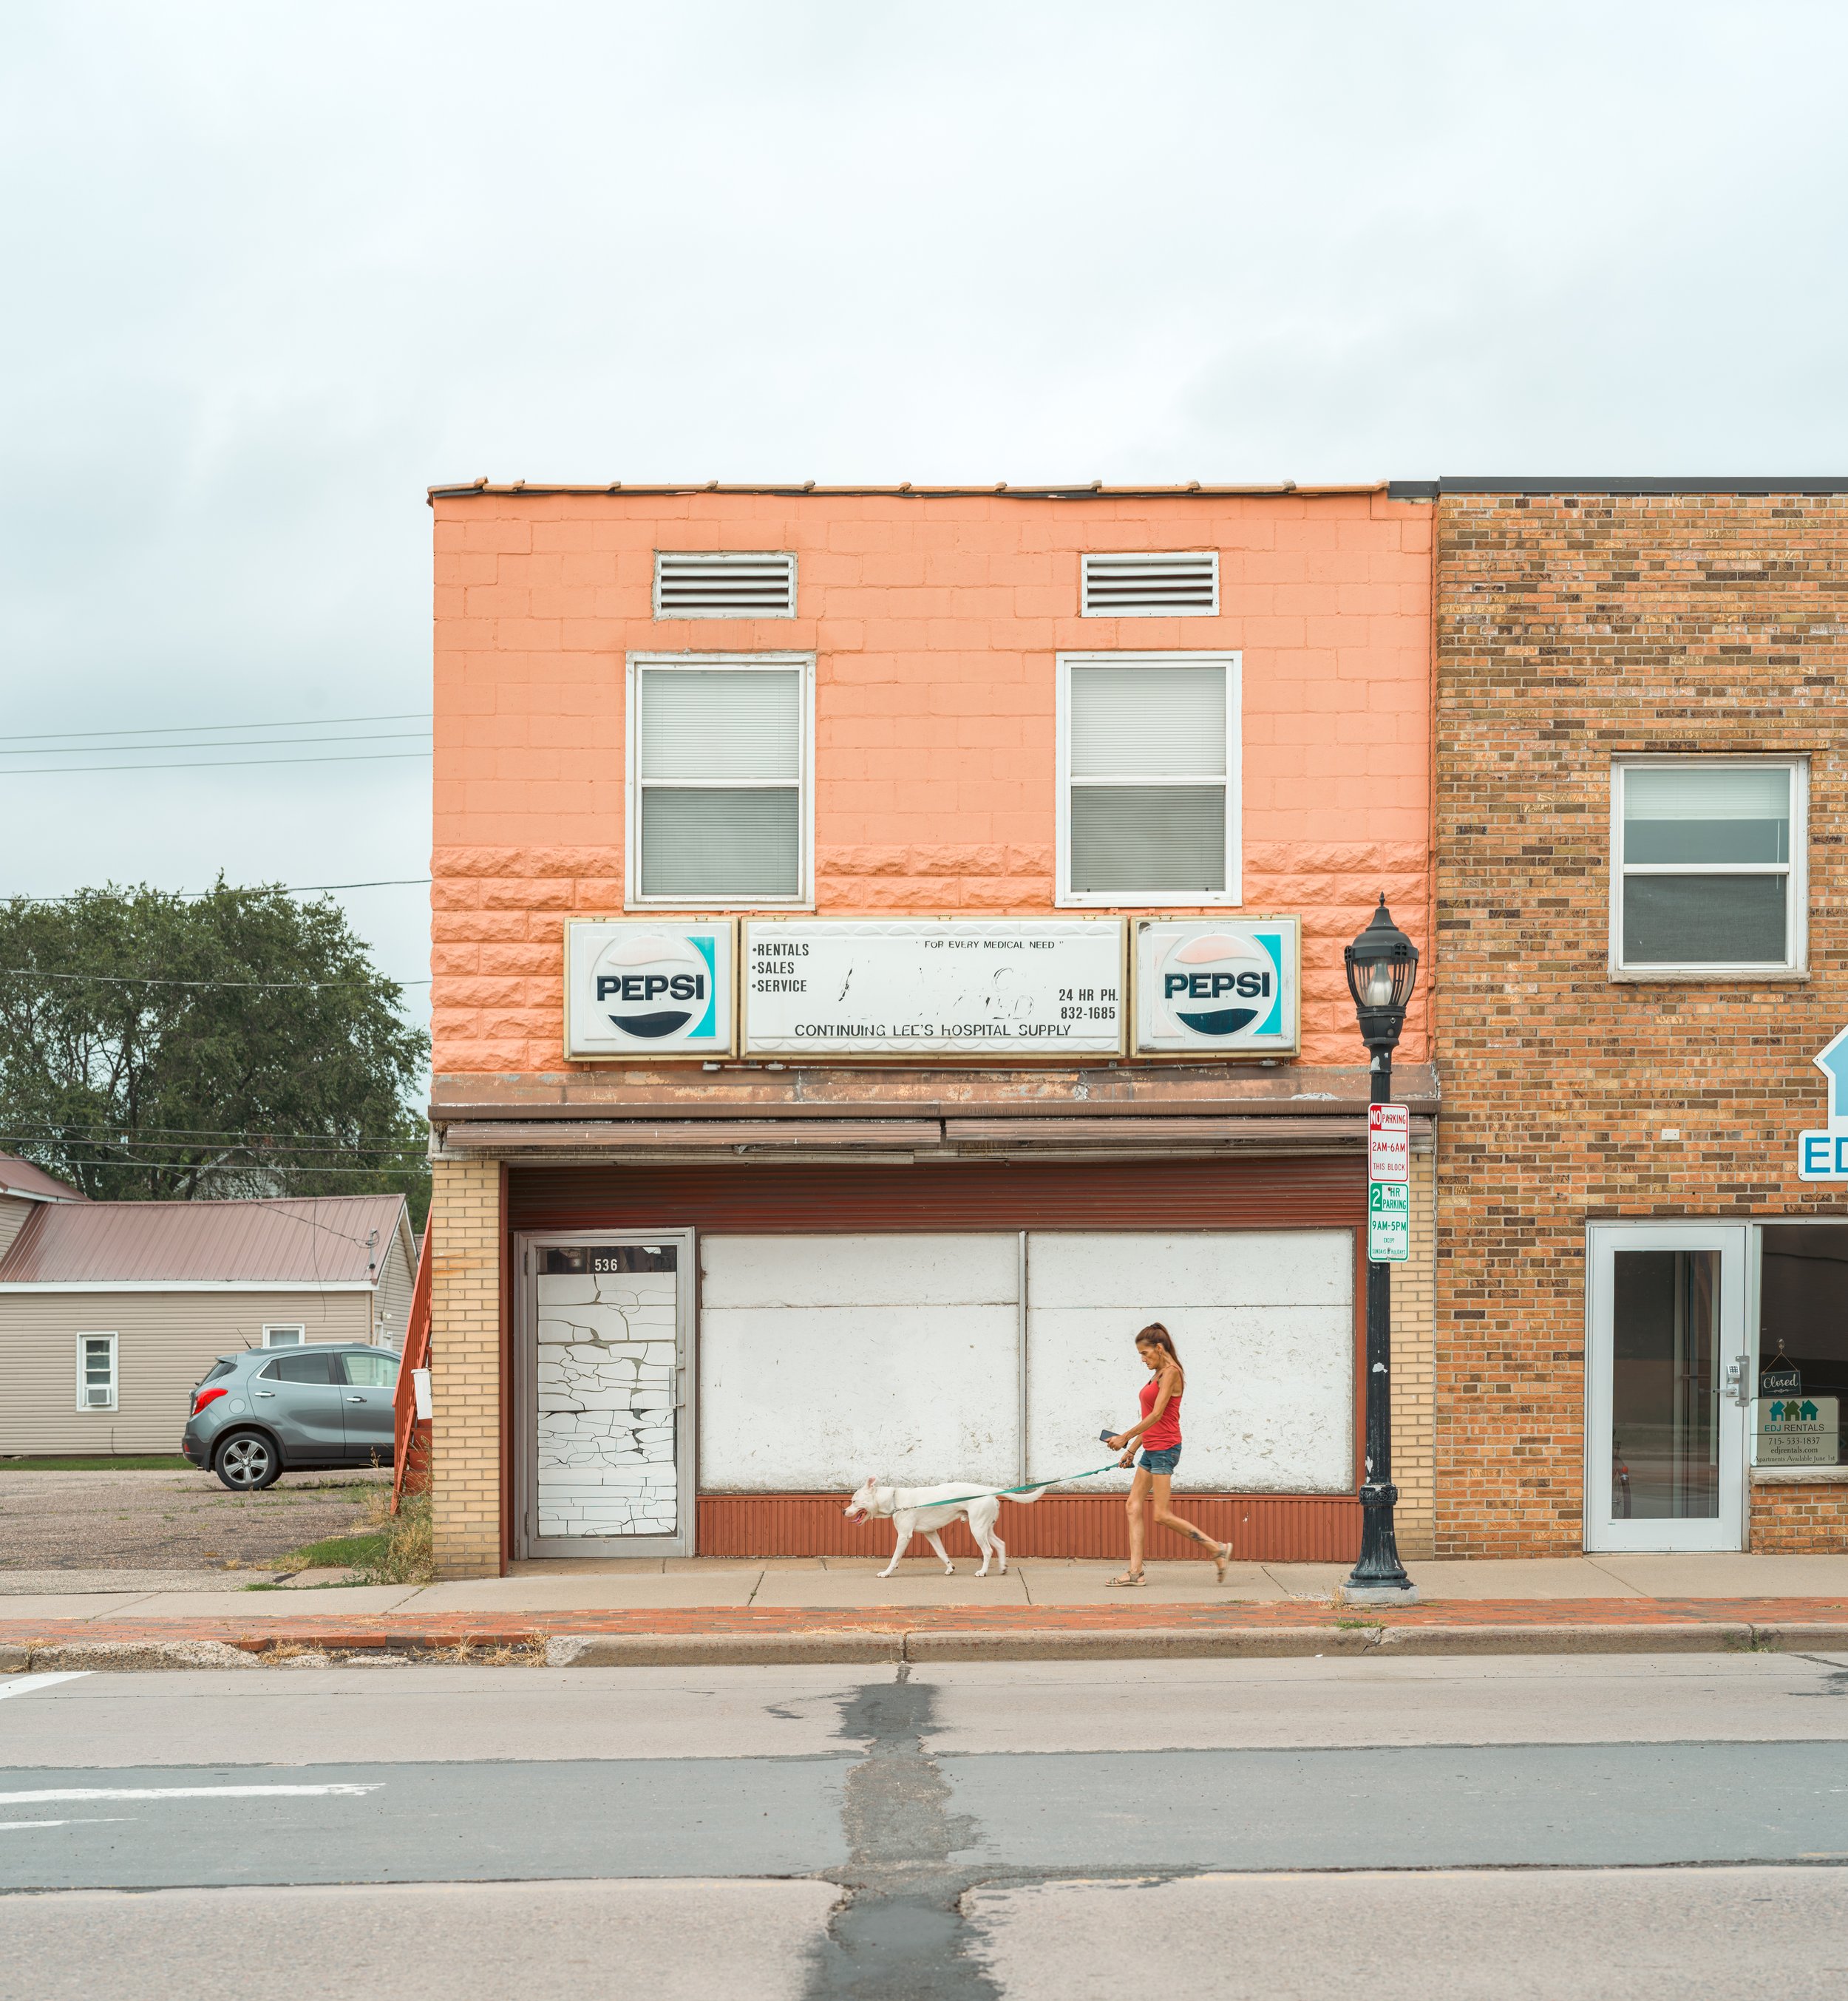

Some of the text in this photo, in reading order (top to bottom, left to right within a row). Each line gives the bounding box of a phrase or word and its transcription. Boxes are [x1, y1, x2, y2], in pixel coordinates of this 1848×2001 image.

[758, 943, 809, 957] RENTALS
[757, 961, 795, 974] SALES
[597, 974, 704, 1001] PEPSI
[757, 979, 807, 992] SERVICE
[1165, 971, 1270, 999] PEPSI
[1059, 988, 1118, 1001] 24 HR PH.
[1061, 1006, 1115, 1019] 832-1685
[795, 1025, 886, 1036] CONTINUING
[893, 1025, 933, 1036] LEE'S
[1019, 1025, 1071, 1036] SUPPLY
[1370, 1110, 1406, 1125] NO PARKING
[1372, 1141, 1405, 1152] 2AM-6AM
[1387, 1163, 1405, 1171] BLOCK
[1372, 1187, 1401, 1207] 2 HR
[1382, 1199, 1406, 1210] PARKING
[1372, 1220, 1406, 1231] 9AM-5PM
[594, 1259, 618, 1271] 536
[1763, 1373, 1798, 1389] Closed
[1784, 1424, 1824, 1432] RENTALS
[1770, 1446, 1818, 1455] edjrentals.com
